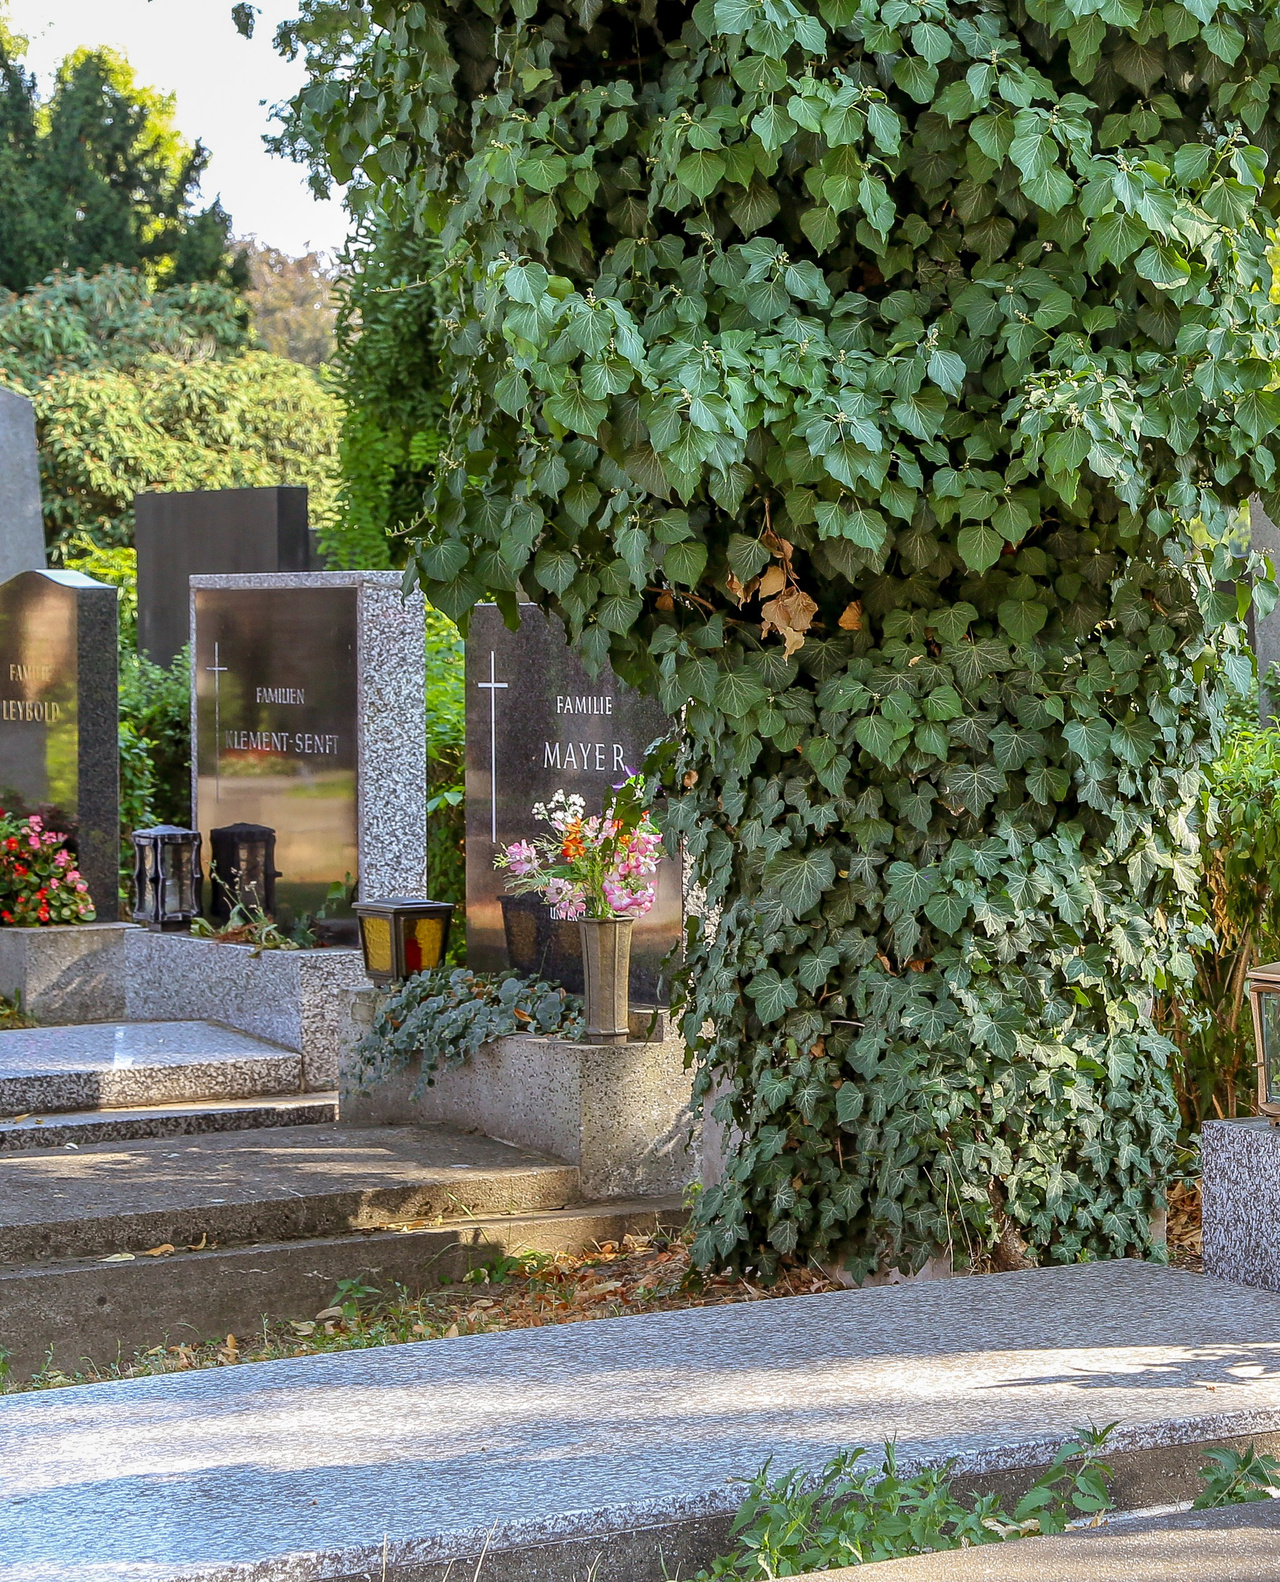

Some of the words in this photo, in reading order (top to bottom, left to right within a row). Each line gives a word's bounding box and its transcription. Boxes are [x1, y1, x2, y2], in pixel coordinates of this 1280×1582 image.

[9, 663, 51, 681] FAMILIE
[256, 687, 304, 704] FAMILIEN
[556, 695, 613, 715] FAMILIE
[3, 700, 60, 722] LEYBOLD
[225, 730, 338, 754] KLEMENT-SENFT
[543, 742, 626, 771] MAYER
